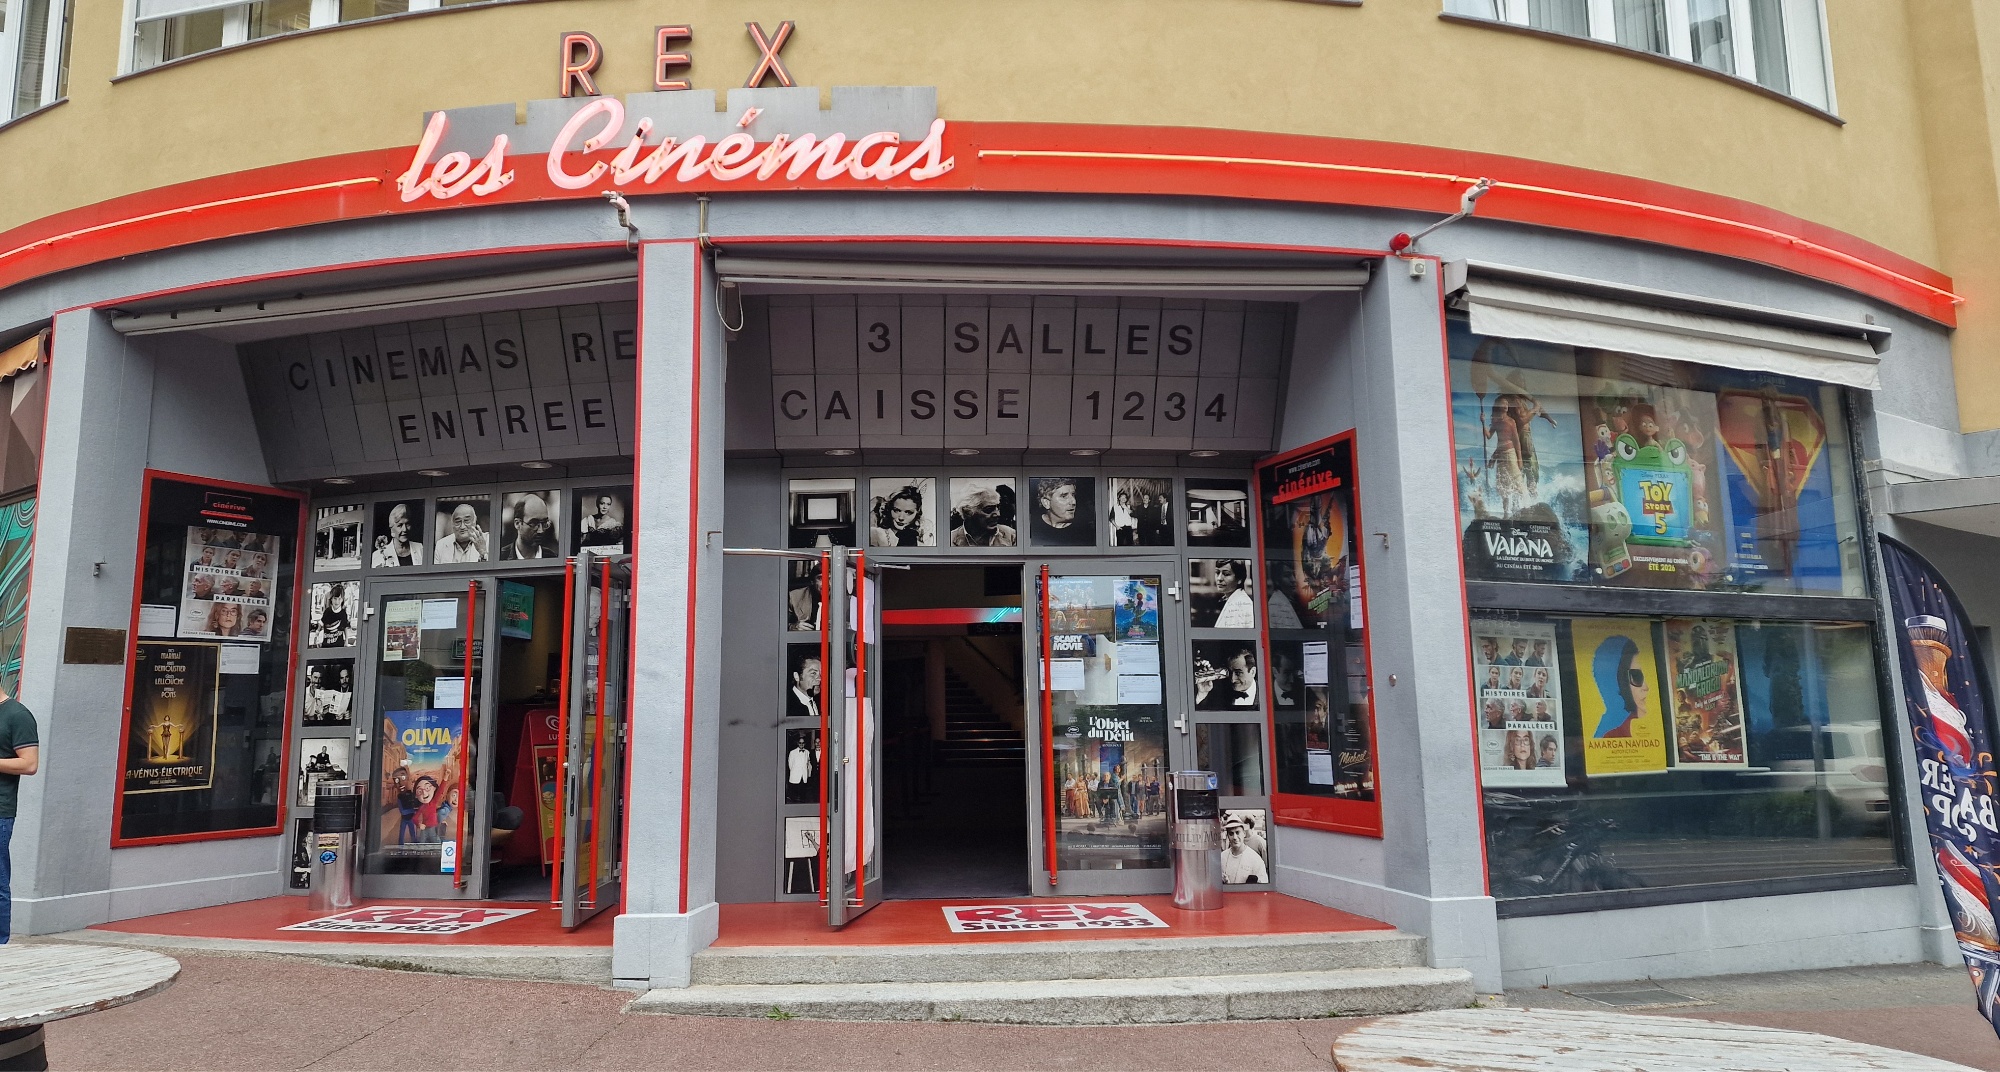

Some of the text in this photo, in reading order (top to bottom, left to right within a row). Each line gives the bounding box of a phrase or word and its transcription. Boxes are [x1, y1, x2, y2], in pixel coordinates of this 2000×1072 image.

[560, 20, 797, 98] REX
[396, 97, 955, 202] les Cinémas
[867, 322, 1194, 356] 3 SALLES
[288, 328, 637, 392] CINEMAS RE
[780, 388, 1228, 423] CAISSE 1234
[398, 398, 606, 444] ENTREE
[1278, 470, 1333, 496] cinérive
[1638, 480, 1673, 502] TOY
[1645, 502, 1671, 511] STORY
[1654, 512, 1668, 535] 5
[1484, 531, 1554, 558] VAIANA
[195, 566, 240, 576] HISTOIRES
[215, 595, 267, 605] PARALLÈLES
[1052, 642, 1084, 651] MOVIE
[1053, 634, 1083, 643] SCARY
[1485, 690, 1526, 698] HISTOIRES
[1089, 716, 1130, 732] L'Objet
[402, 728, 452, 746] OLIVIA
[1087, 727, 1104, 738] du
[1104, 727, 1135, 741] Délit
[1588, 739, 1660, 750] AMARGA NAVIDAD
[1338, 750, 1368, 767] Michael
[333, 908, 513, 925] REX
[955, 904, 1139, 923] REX
[961, 917, 1154, 931] Since 1933
